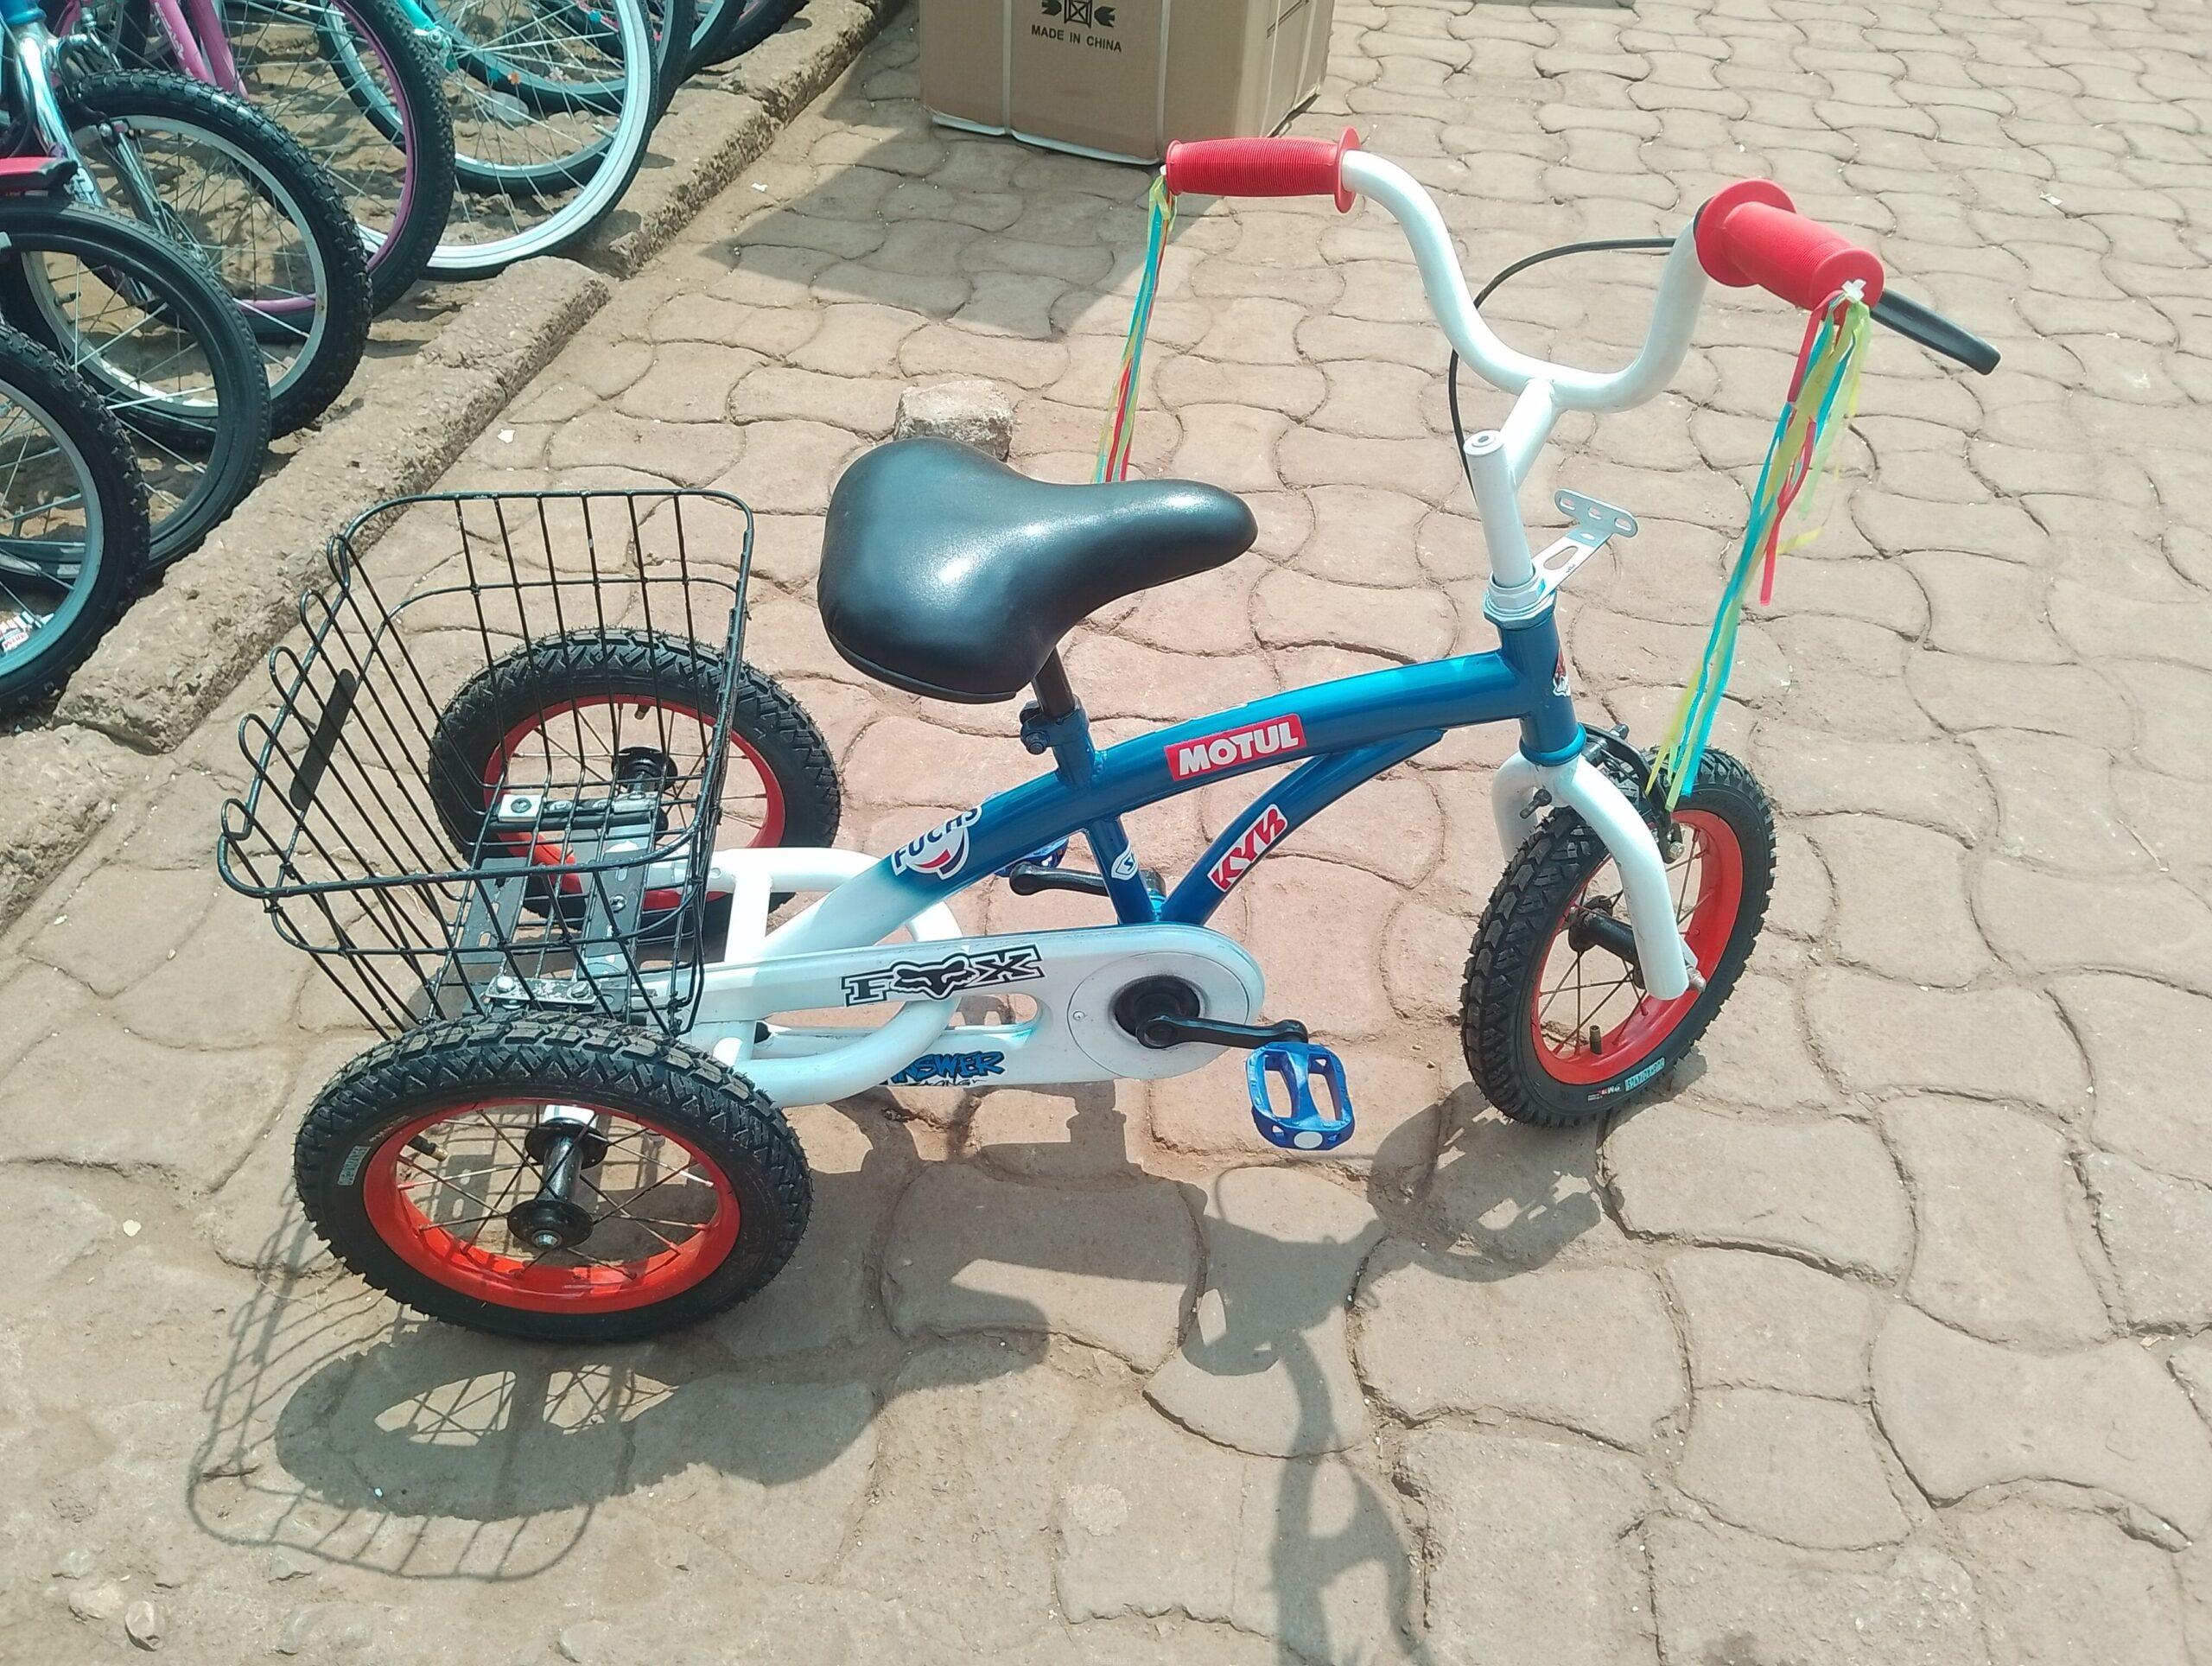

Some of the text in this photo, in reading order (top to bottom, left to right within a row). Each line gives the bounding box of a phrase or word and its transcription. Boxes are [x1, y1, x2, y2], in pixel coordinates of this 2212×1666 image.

[1031, 24, 1122, 53] MADE IN CHINA
[1179, 722, 1299, 776] MOTUL
[1210, 808, 1287, 891] KYB
[890, 1050, 1006, 1084] NSWER
